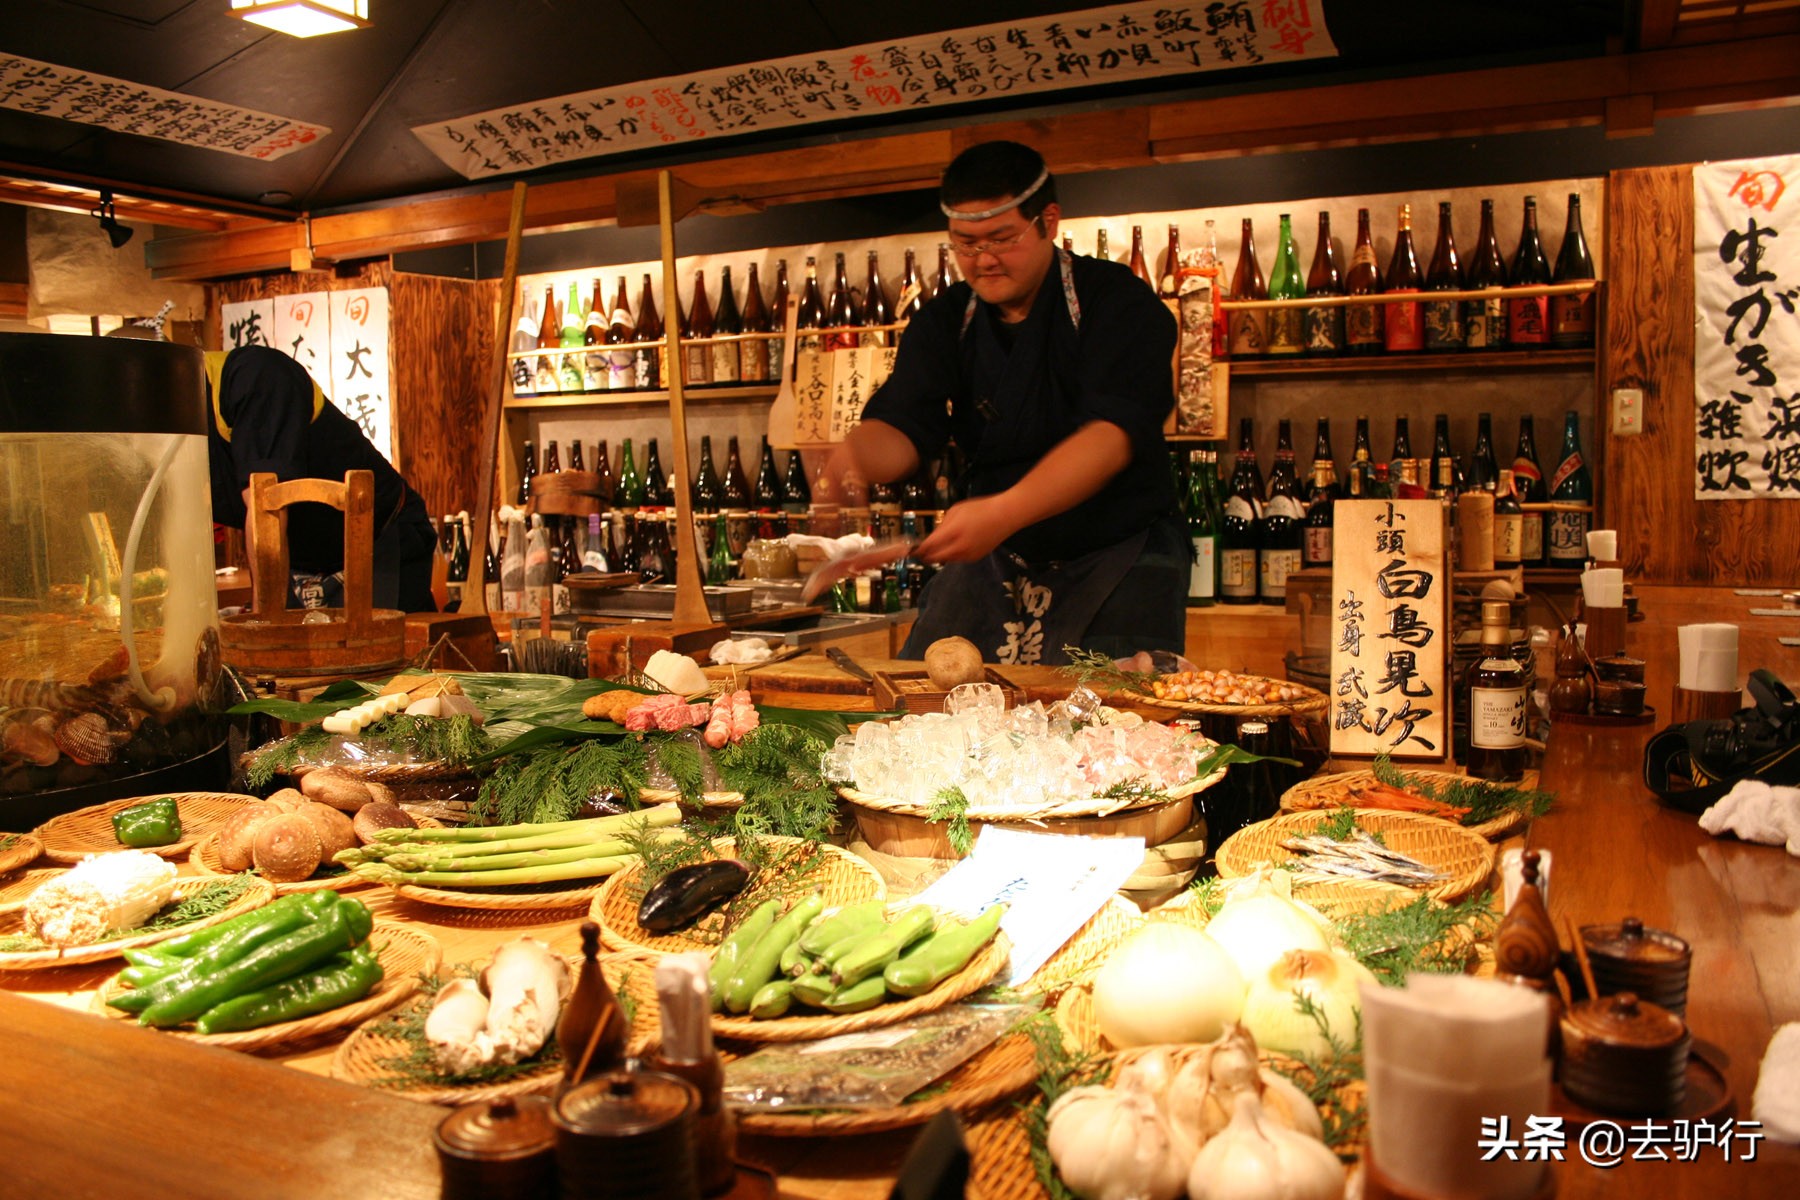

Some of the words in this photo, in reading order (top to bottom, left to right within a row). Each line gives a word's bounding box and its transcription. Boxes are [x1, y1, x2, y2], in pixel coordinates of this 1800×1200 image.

[1262, 0, 1315, 55] 刺身
[1728, 170, 1785, 212] 旬
[1374, 501, 1406, 557] 小頭
[1338, 588, 1365, 658] 出身
